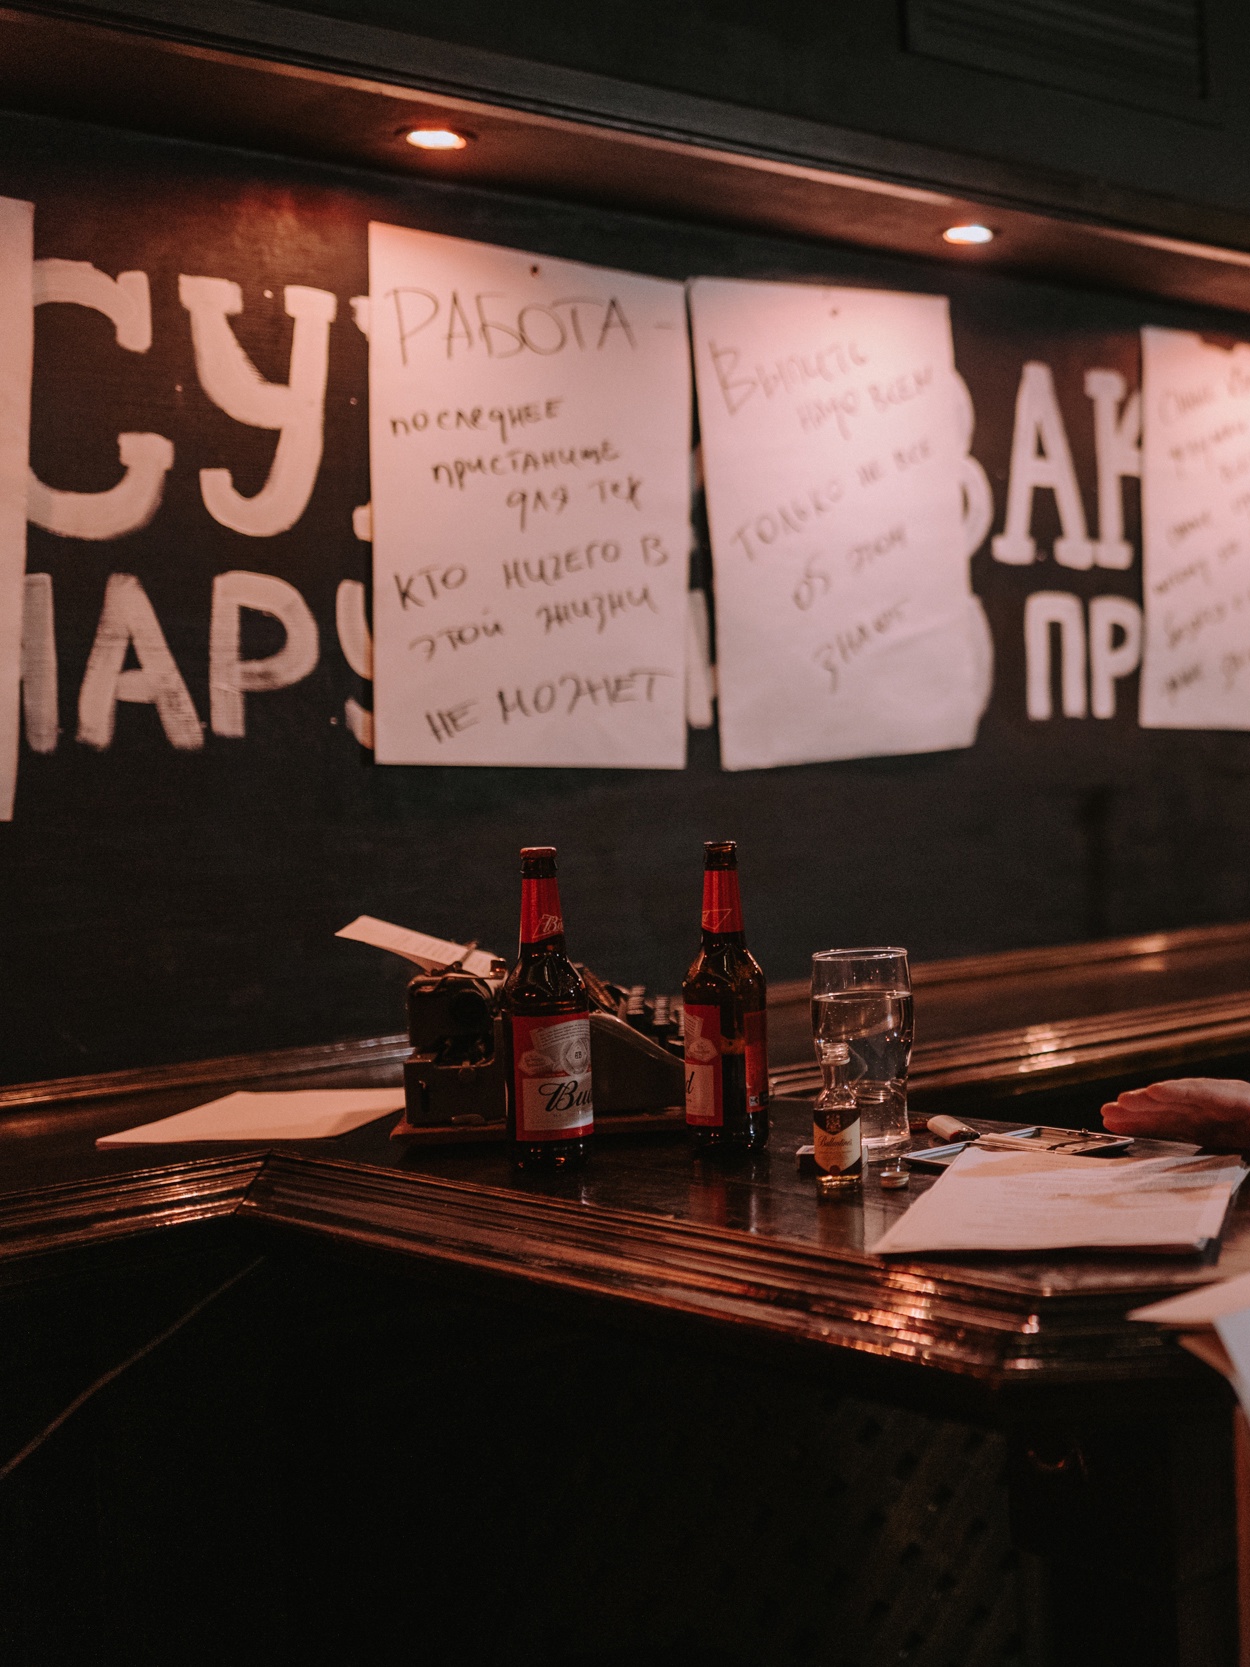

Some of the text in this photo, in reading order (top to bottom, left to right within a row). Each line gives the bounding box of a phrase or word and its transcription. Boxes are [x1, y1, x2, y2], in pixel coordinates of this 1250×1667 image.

[384, 286, 639, 367] РАБОТА
[393, 564, 468, 611] КТО
[502, 541, 621, 589] НИЧЕГО
[425, 667, 678, 744] НЕ МОЖЕТ
